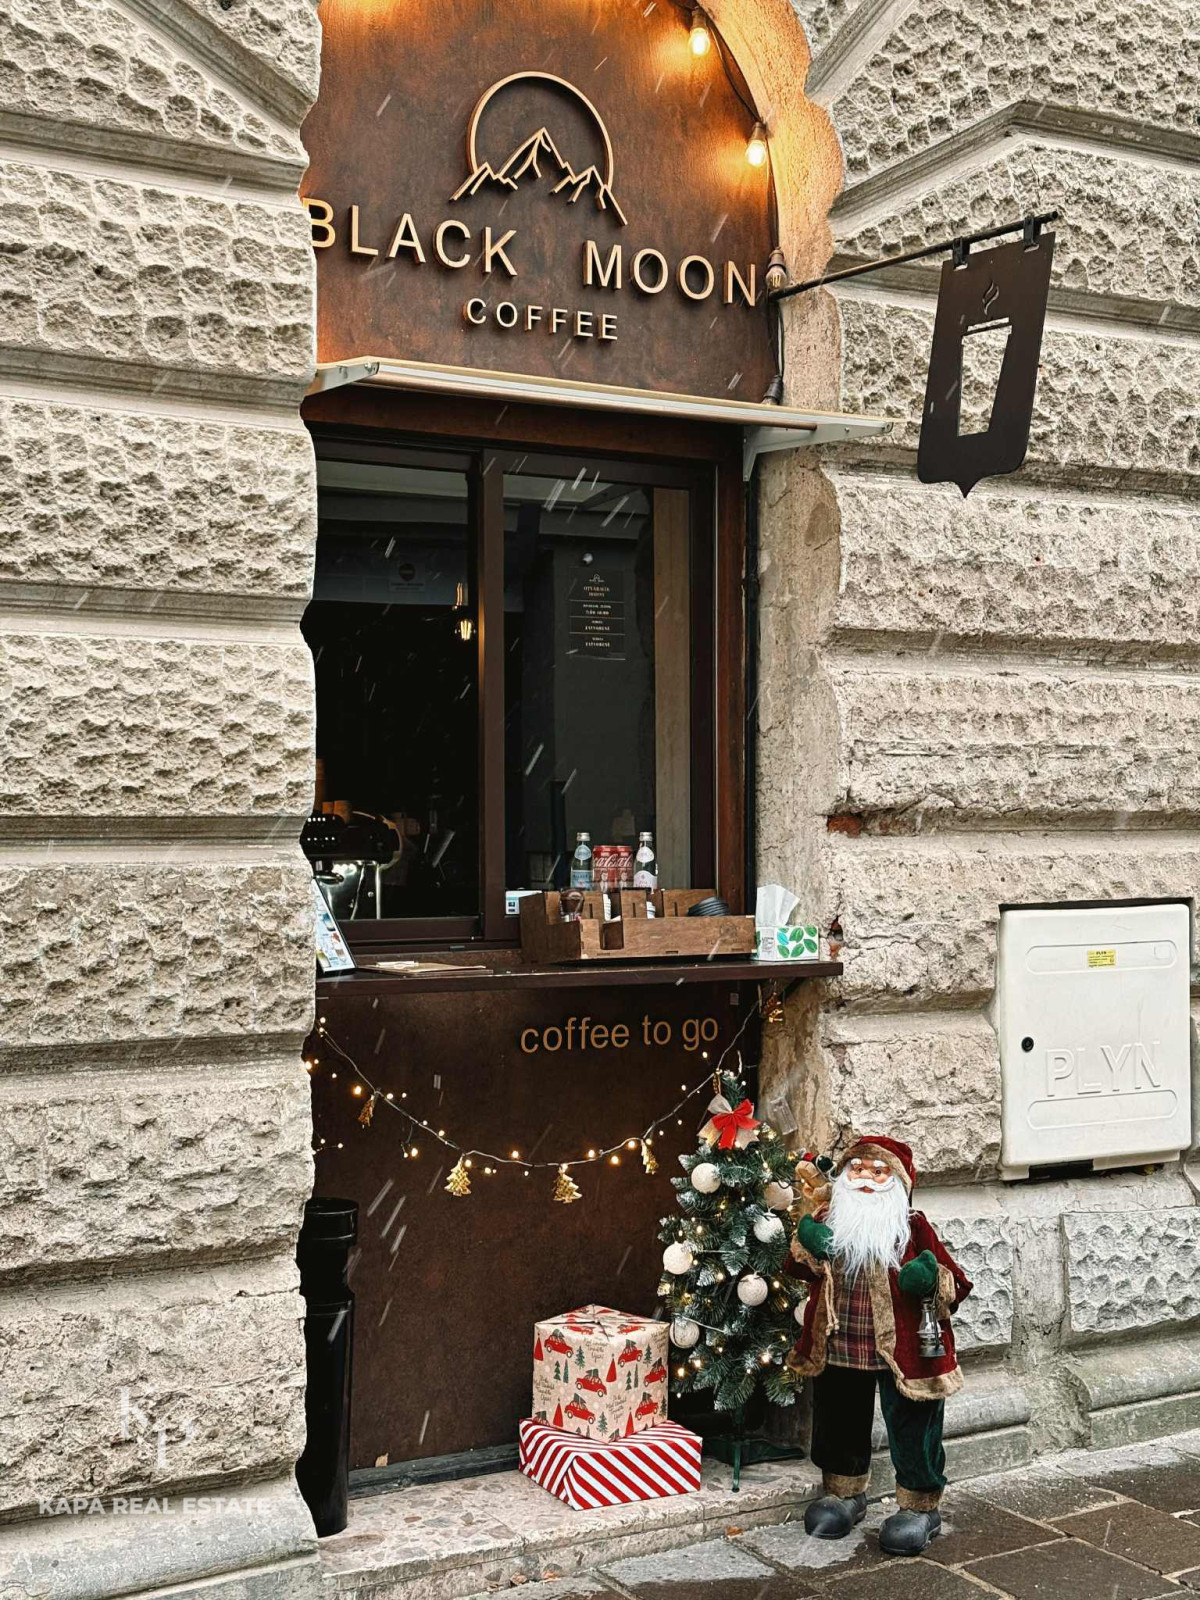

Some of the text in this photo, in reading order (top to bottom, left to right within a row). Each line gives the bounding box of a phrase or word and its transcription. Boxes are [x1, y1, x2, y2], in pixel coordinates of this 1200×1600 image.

[302, 197, 756, 307] BLACK MOON
[464, 298, 618, 341] COFFEE
[520, 1014, 719, 1054] coffee to go
[1047, 1040, 1161, 1097] PLYN
